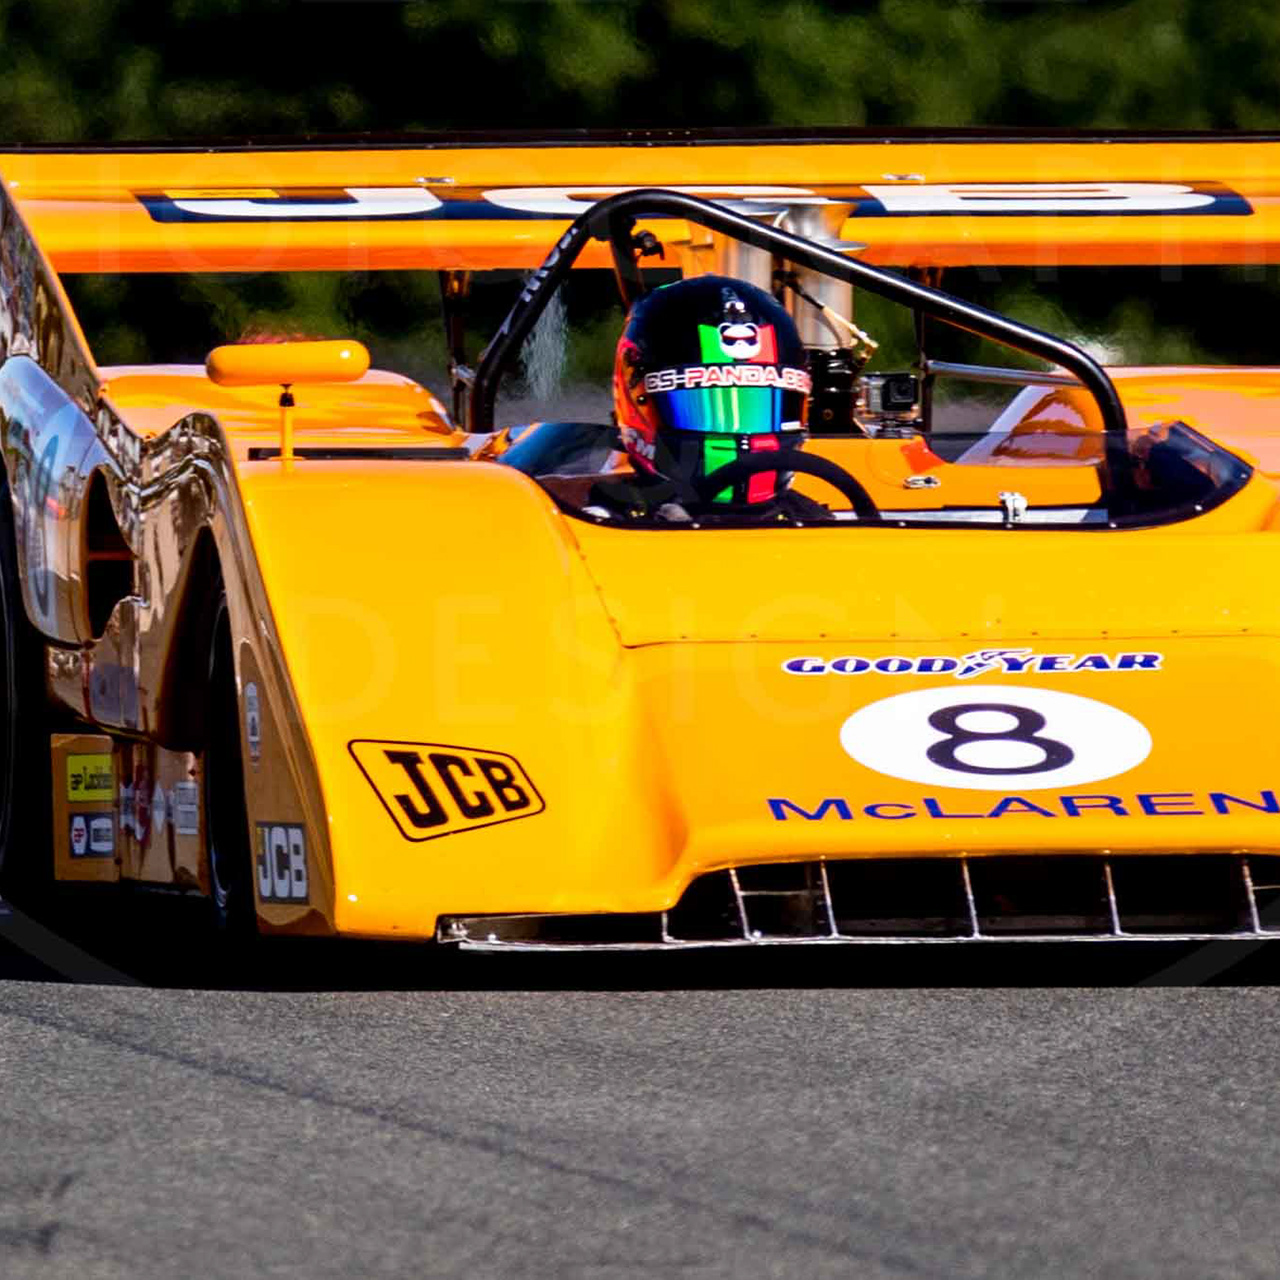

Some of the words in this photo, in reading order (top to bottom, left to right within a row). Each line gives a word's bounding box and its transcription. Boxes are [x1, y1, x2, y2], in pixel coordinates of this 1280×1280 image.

[926, 703, 1075, 775] 8
[382, 750, 531, 828] JCB
[256, 827, 307, 898] JCB
